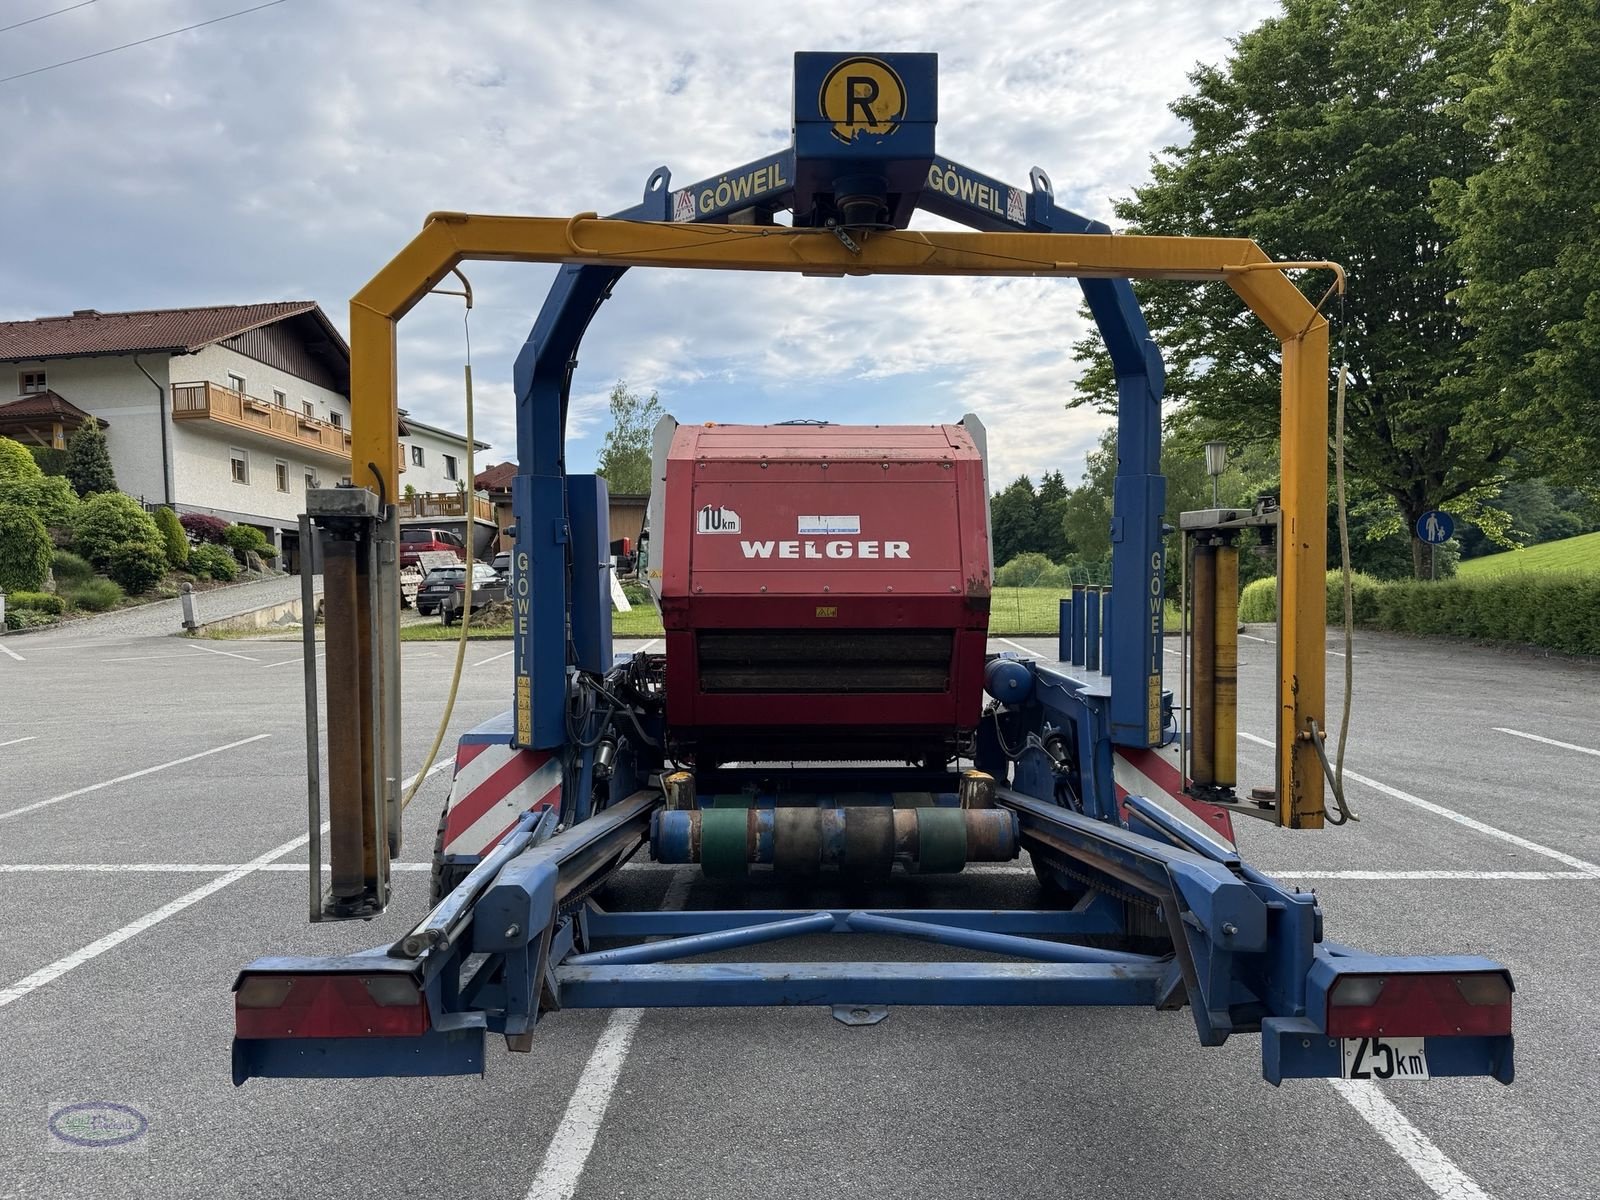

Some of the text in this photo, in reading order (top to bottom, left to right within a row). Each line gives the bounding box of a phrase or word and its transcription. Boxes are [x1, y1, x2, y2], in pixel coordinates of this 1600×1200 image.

[846, 76, 879, 127] R
[699, 163, 786, 214] GÖWEIL
[928, 164, 1004, 215] GÖWEIL
[740, 540, 911, 559] WELGER
[517, 552, 530, 675] GÖWEIL
[1150, 552, 1162, 674] GÖWEIL
